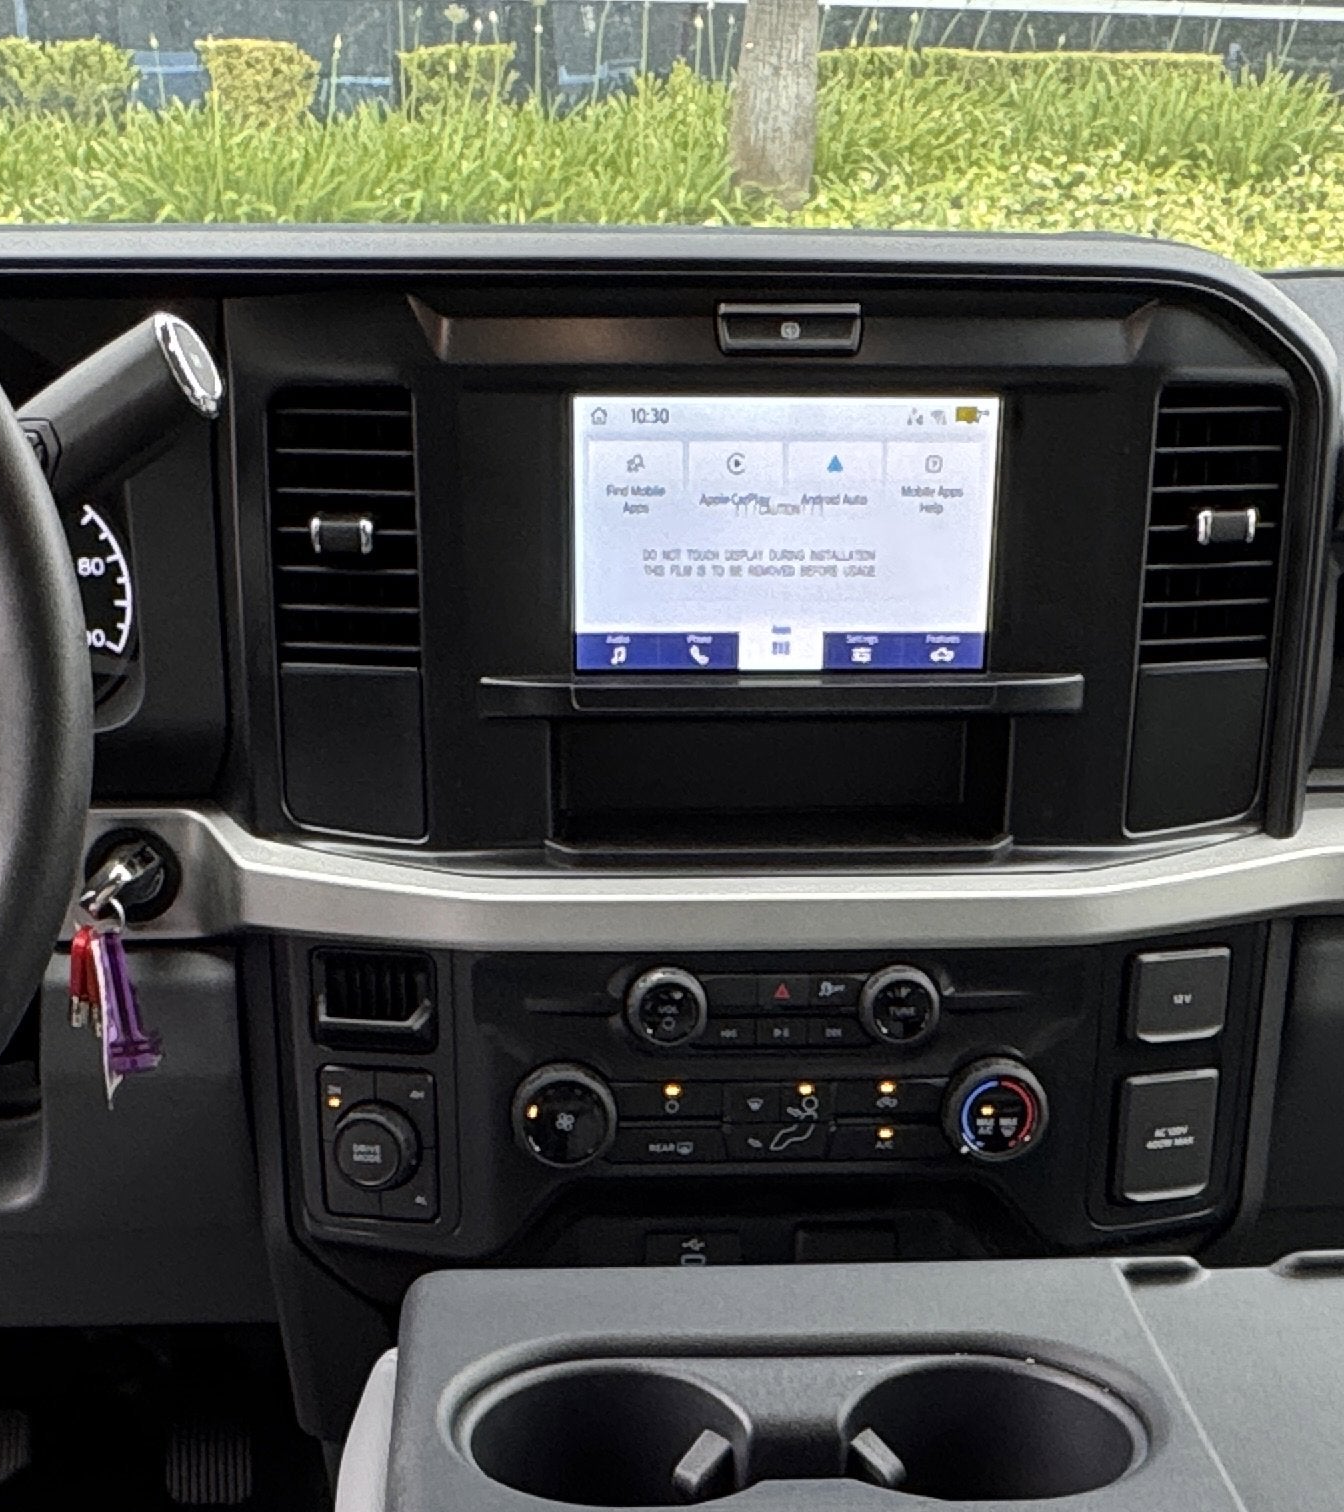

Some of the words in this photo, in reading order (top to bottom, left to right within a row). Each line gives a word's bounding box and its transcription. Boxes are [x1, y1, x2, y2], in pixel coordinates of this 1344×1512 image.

[631, 408, 670, 424] 10:30
[607, 485, 629, 497] Find
[631, 485, 666, 497] Mobile
[938, 485, 964, 498] Apps
[801, 494, 840, 505] Android
[843, 494, 868, 505] Auto
[623, 502, 649, 514] Apps
[919, 503, 944, 515] Help
[643, 549, 657, 561] DO
[663, 549, 681, 561] NOT
[687, 549, 719, 561] TOUCH
[725, 549, 763, 561] DISPLAY
[77, 557, 105, 576] 80
[648, 1142, 676, 1153] REAR
